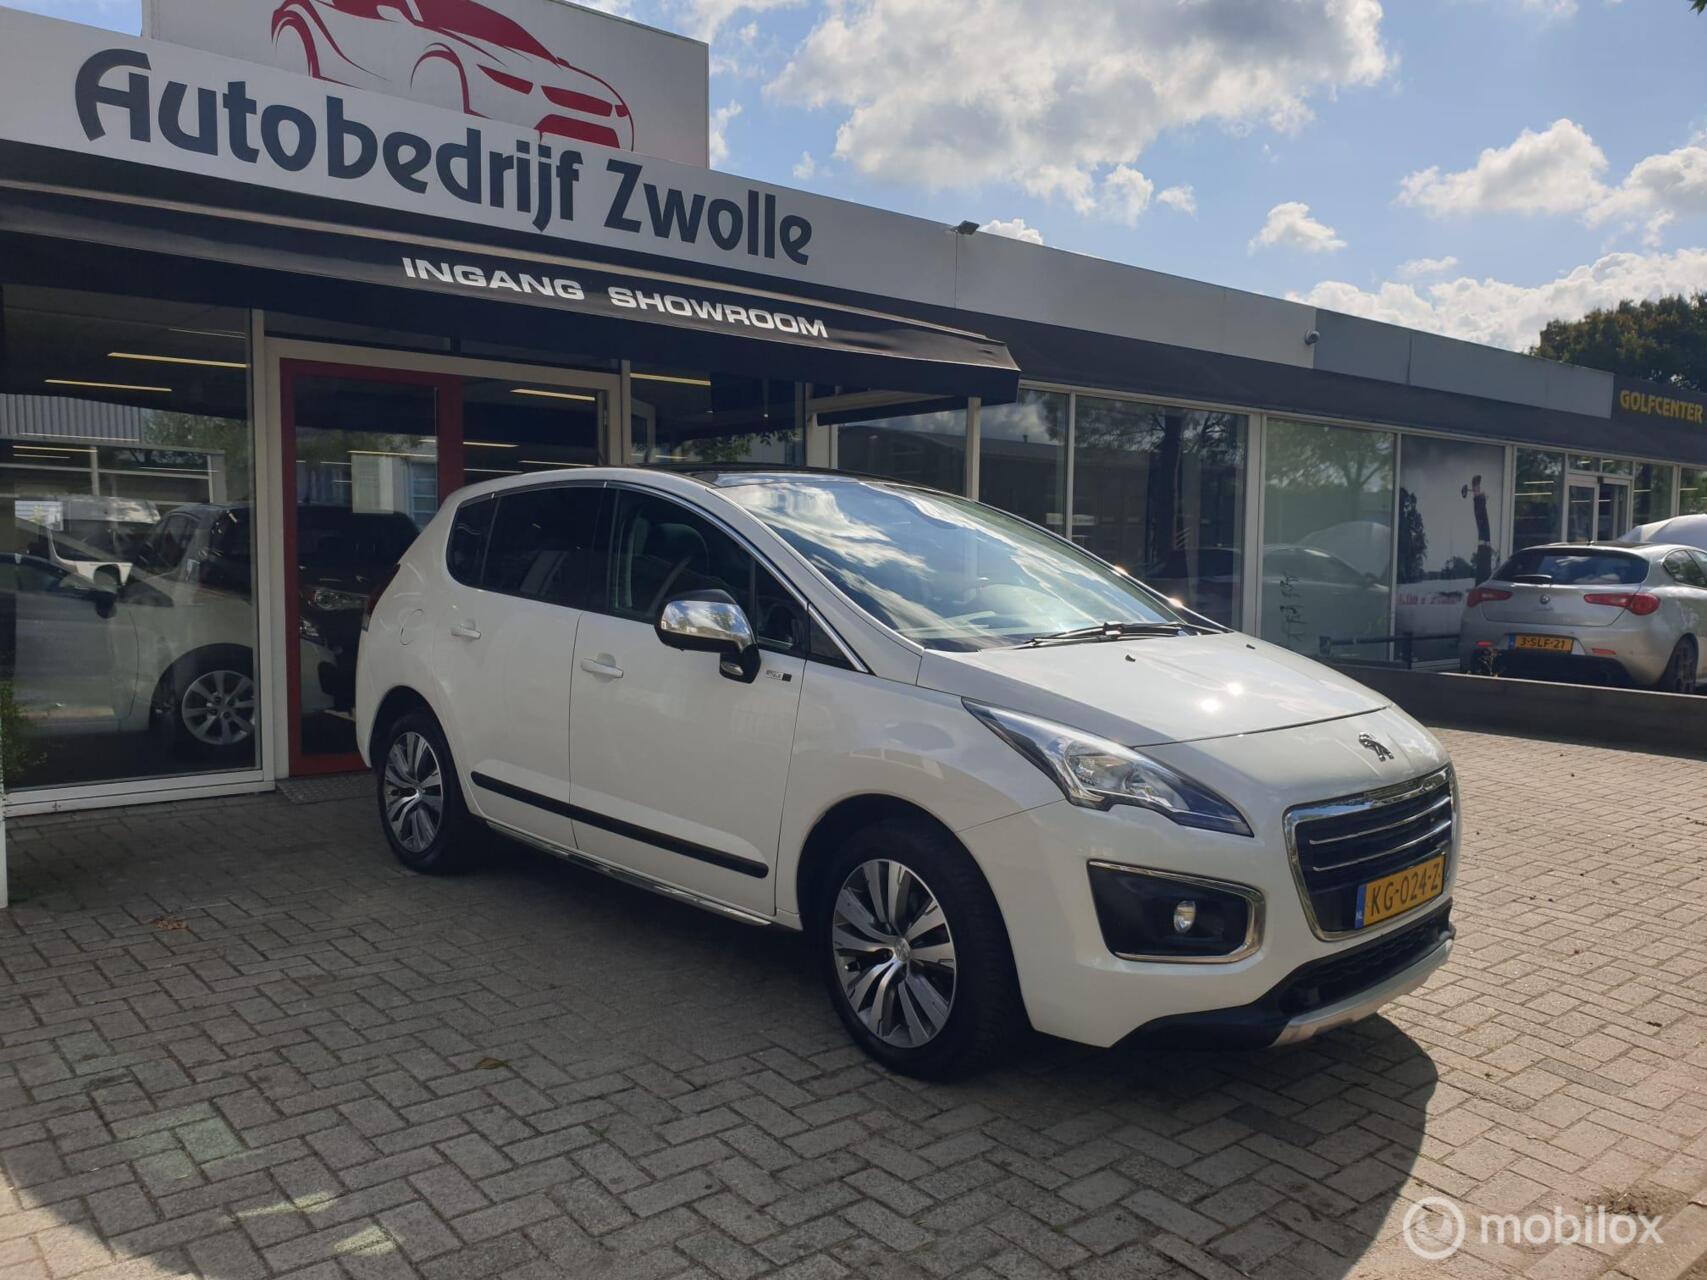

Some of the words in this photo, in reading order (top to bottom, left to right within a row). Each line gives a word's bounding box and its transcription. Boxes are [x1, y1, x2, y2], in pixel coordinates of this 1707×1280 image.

[75, 47, 584, 233] Autobedrijf
[603, 158, 813, 266] Zwolle
[402, 256, 585, 303] INGANG
[607, 285, 829, 339] SHOWROOM
[1619, 389, 1704, 424] GOLFCENTER
[1371, 862, 1441, 916] KG-024-Z
